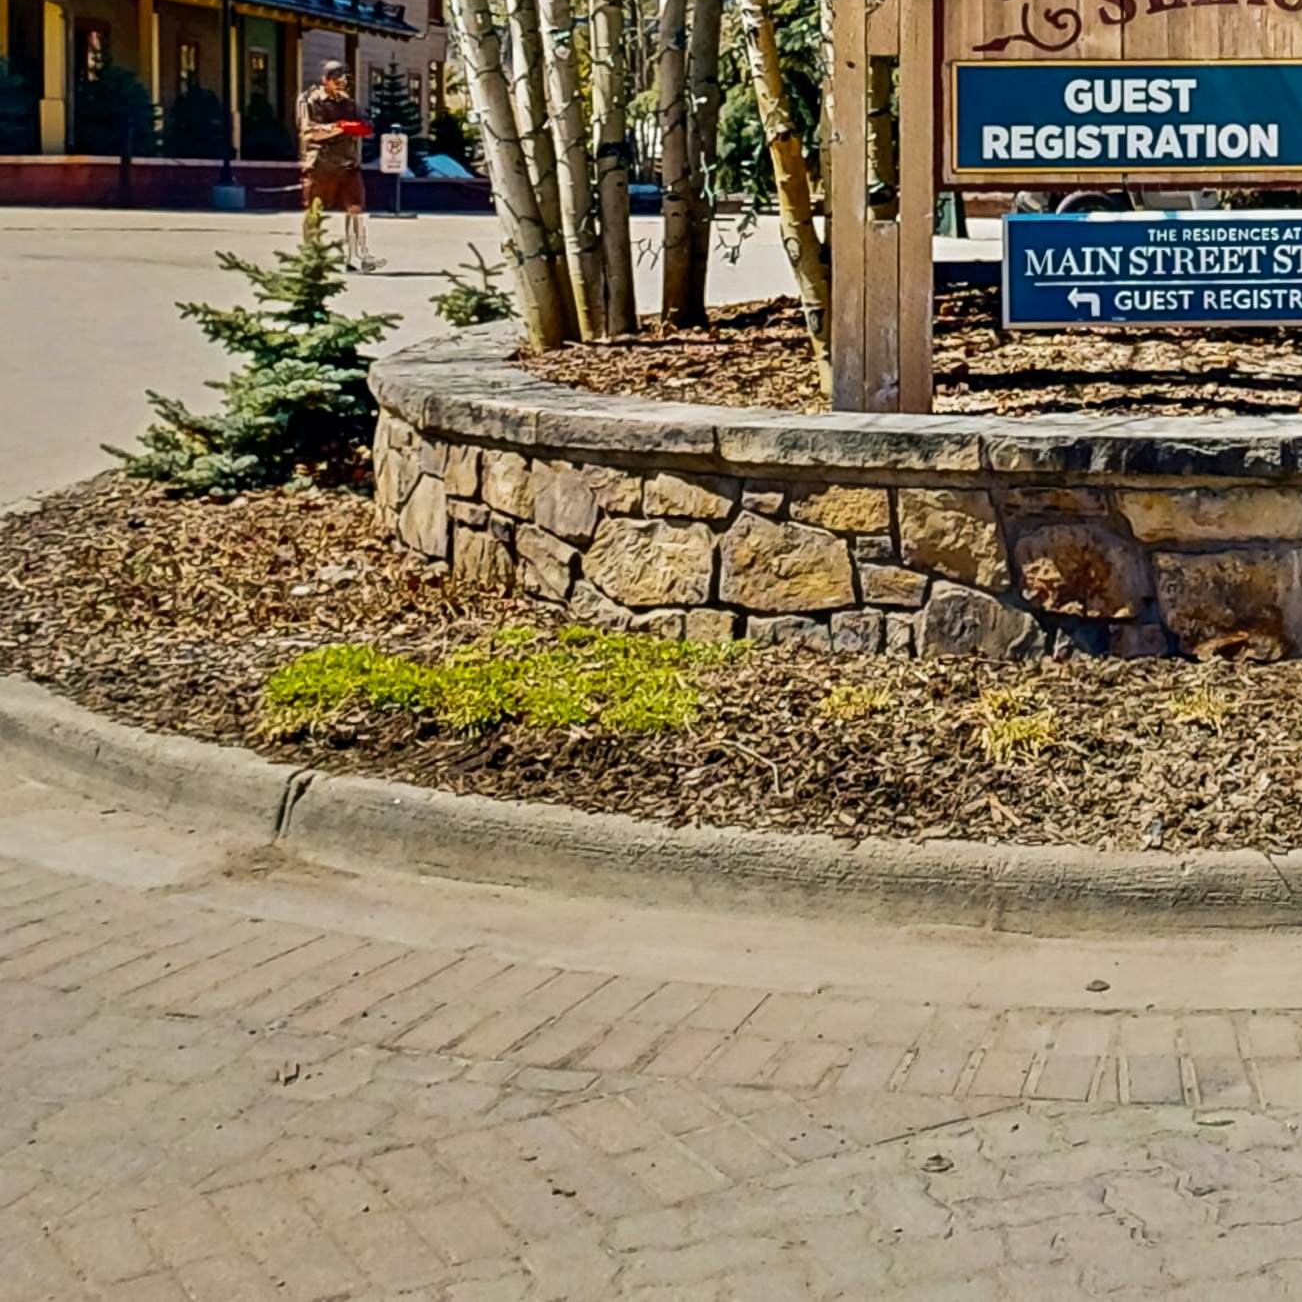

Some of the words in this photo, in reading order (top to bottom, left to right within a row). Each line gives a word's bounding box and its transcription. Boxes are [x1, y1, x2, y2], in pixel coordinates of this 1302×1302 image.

[1064, 79, 1197, 113] GUEST
[982, 124, 1278, 159] REGISTRATION
[1148, 228, 1177, 242] THE
[1182, 227, 1279, 242] RESIDENCES
[1282, 227, 1302, 240] AT
[1024, 247, 1123, 276] MAIN
[1129, 246, 1267, 275] STREET
[1114, 290, 1194, 311] GUEST
